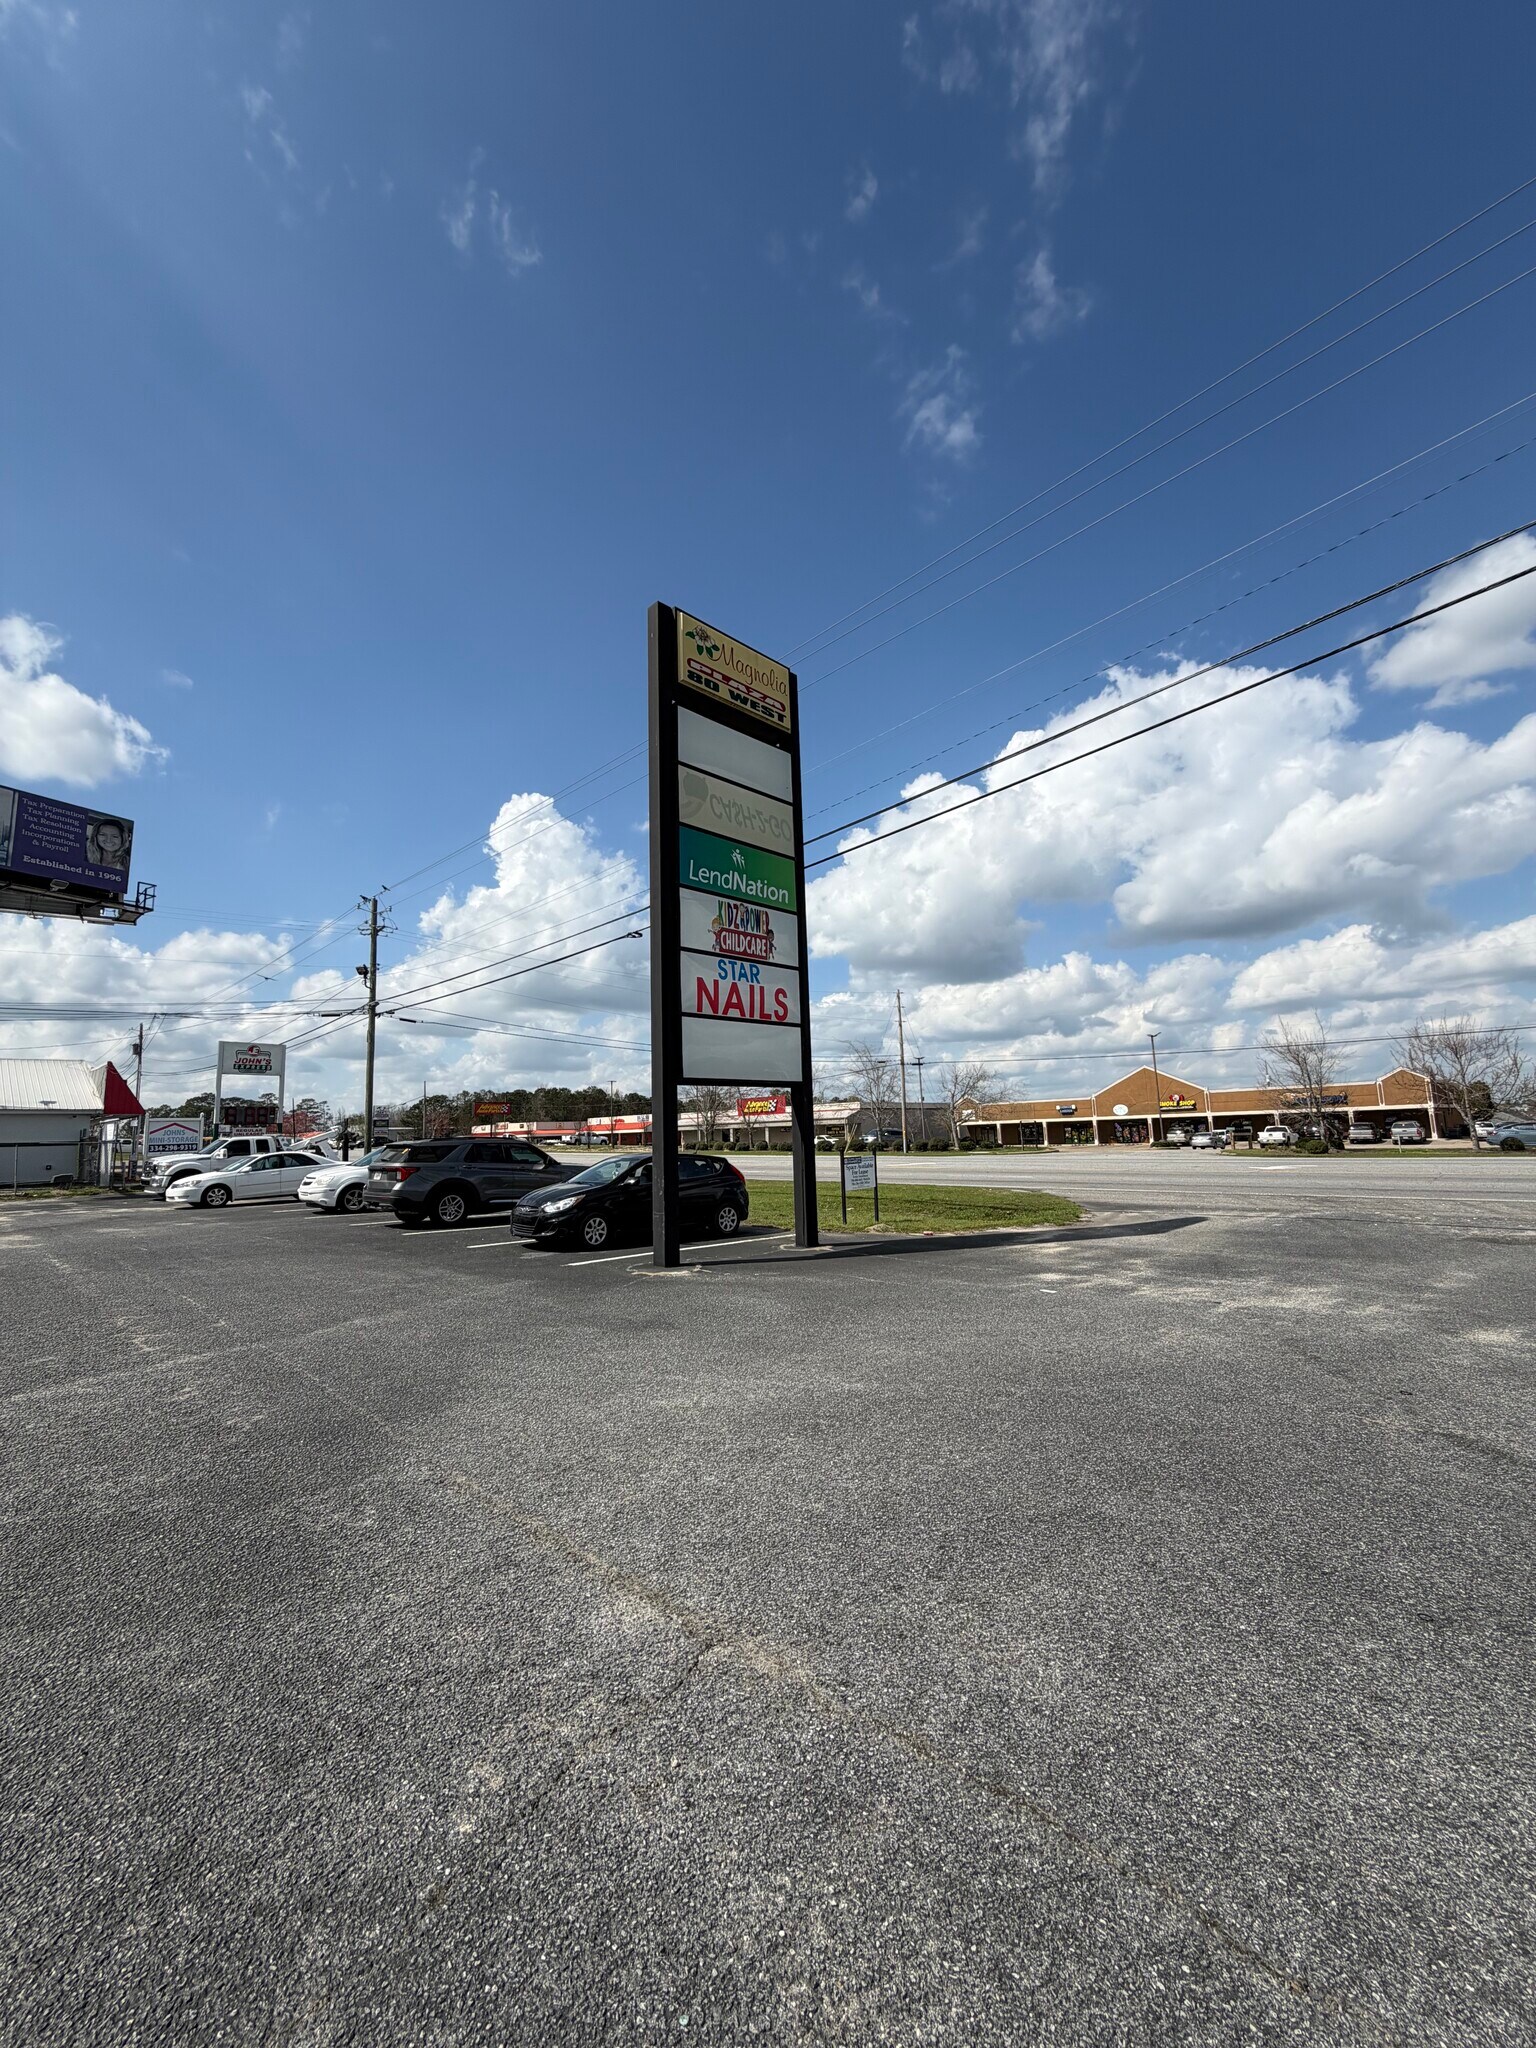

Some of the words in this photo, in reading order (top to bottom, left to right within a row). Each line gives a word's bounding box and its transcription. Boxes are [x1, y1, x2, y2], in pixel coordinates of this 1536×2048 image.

[707, 643, 788, 696] Magnolia
[687, 669, 720, 693] 80
[728, 688, 787, 723] WEST
[688, 659, 785, 711] PLAZA
[22, 797, 38, 807] Tax
[40, 802, 85, 820] Preparation
[27, 806, 43, 816] Tax
[45, 811, 80, 827] Planning
[22, 813, 38, 822] Tax
[40, 817, 82, 834] Resolution
[29, 823, 75, 840] Accounting
[21, 828, 80, 848] Incorporations
[41, 840, 69, 853] Payroll
[23, 854, 82, 874] Established
[85, 868, 95, 877] in
[98, 871, 122, 882] 1996
[689, 859, 789, 904] LendNation
[720, 931, 767, 957] CHILDCARE
[717, 959, 761, 984] STAR
[696, 976, 789, 1022] NAILS
[234, 1057, 272, 1065] JOHN'S
[149, 1135, 198, 1144] MINI-STORAGE
